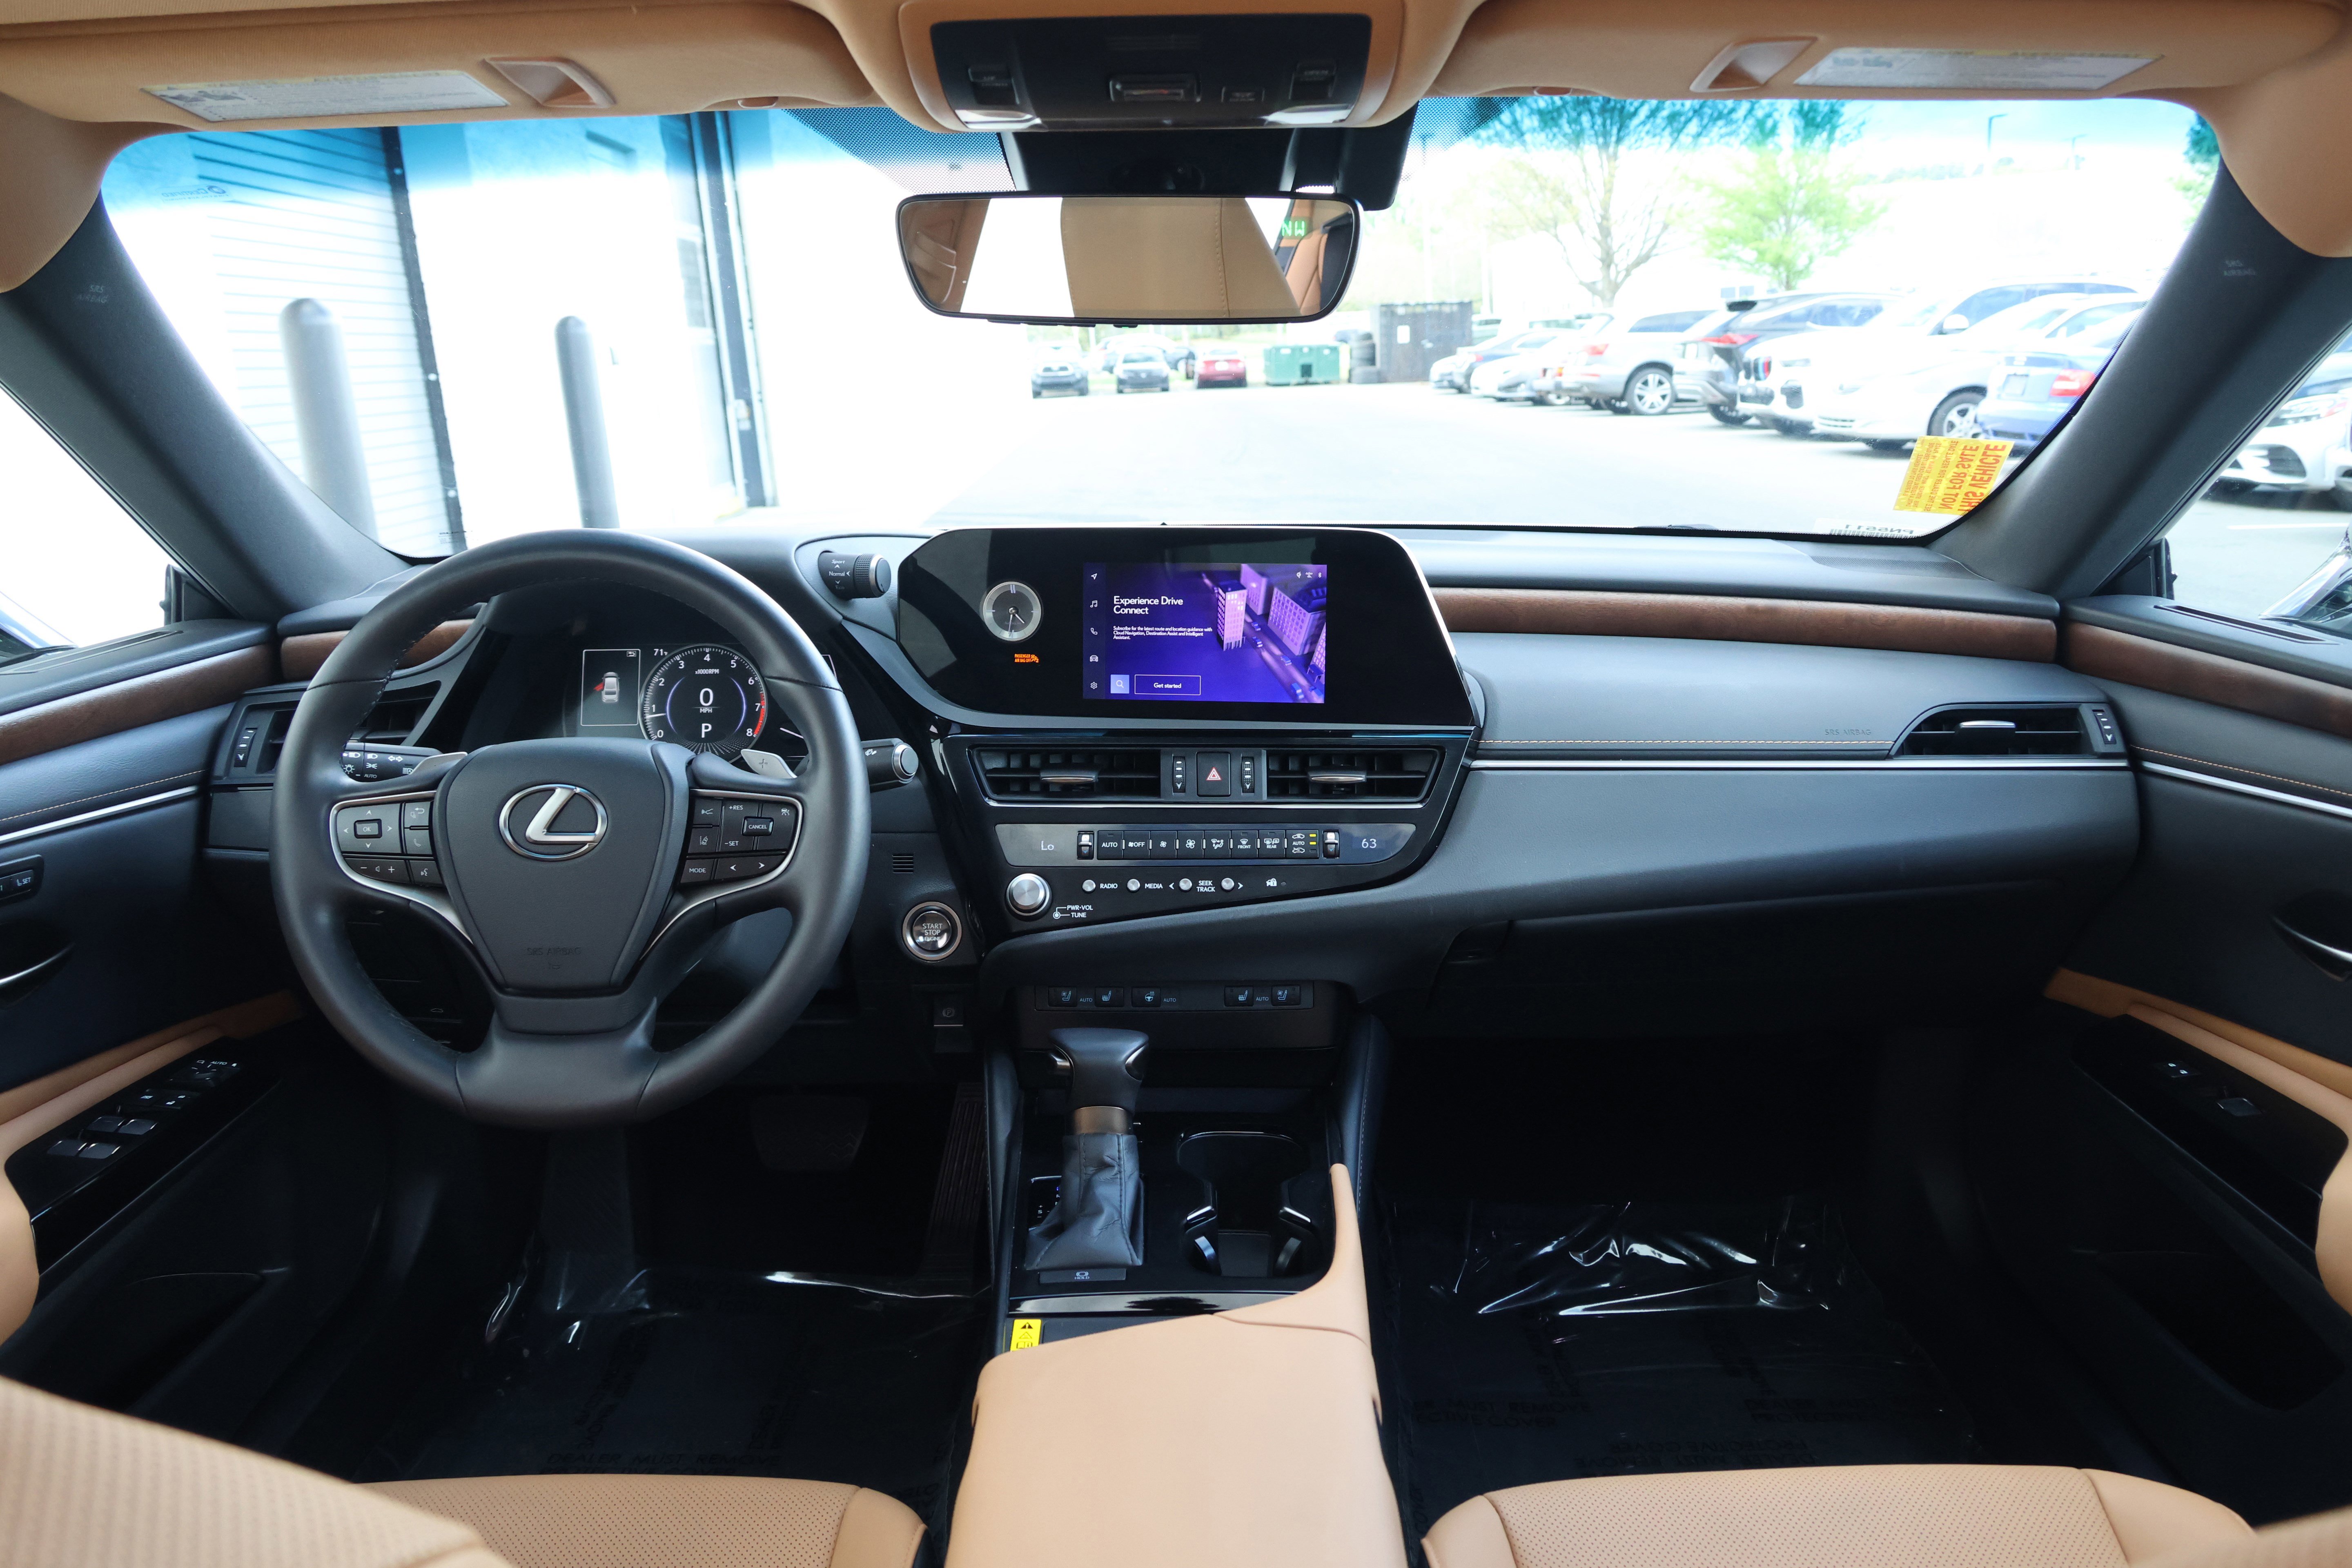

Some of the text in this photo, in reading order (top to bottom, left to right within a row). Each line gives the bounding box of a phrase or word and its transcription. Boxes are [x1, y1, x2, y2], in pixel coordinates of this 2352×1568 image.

[1282, 220, 1305, 236] NW
[1114, 596, 1183, 606] Experience Drive
[1113, 605, 1149, 614] Connect
[659, 678, 664, 686] 2
[699, 688, 714, 706] 0
[755, 703, 761, 711] 7
[702, 723, 712, 738] P
[746, 728, 753, 737] 8
[1041, 840, 1054, 851] Lo
[1361, 838, 1376, 849] 63
[527, 947, 582, 956] SRS AIRBAG
[547, 1454, 781, 1467] DEALER MUST REMOVE
